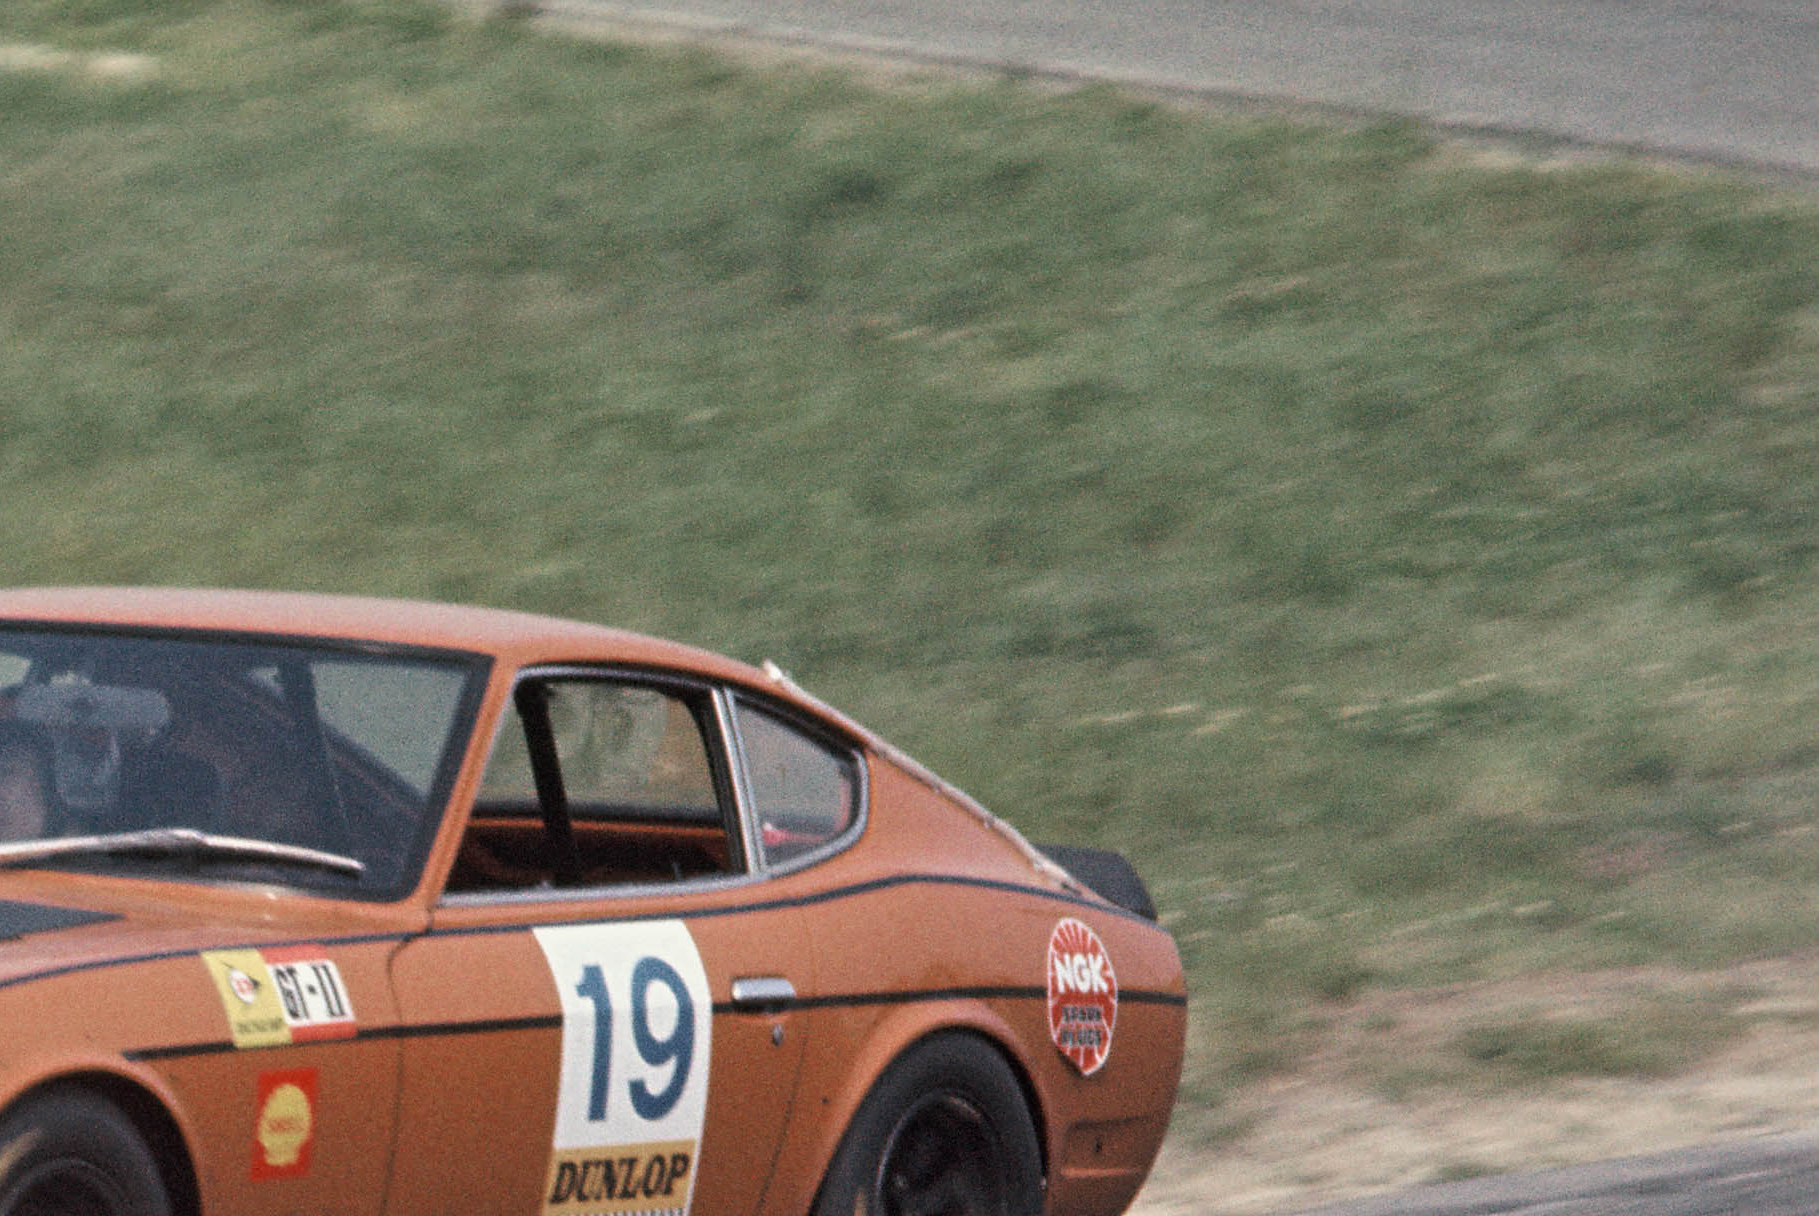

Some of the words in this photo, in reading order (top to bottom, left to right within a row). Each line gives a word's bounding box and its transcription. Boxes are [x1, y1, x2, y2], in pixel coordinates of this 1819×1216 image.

[1054, 952, 1108, 994] NGK
[573, 955, 695, 1122] 19
[549, 1153, 690, 1205] DUNLOP
